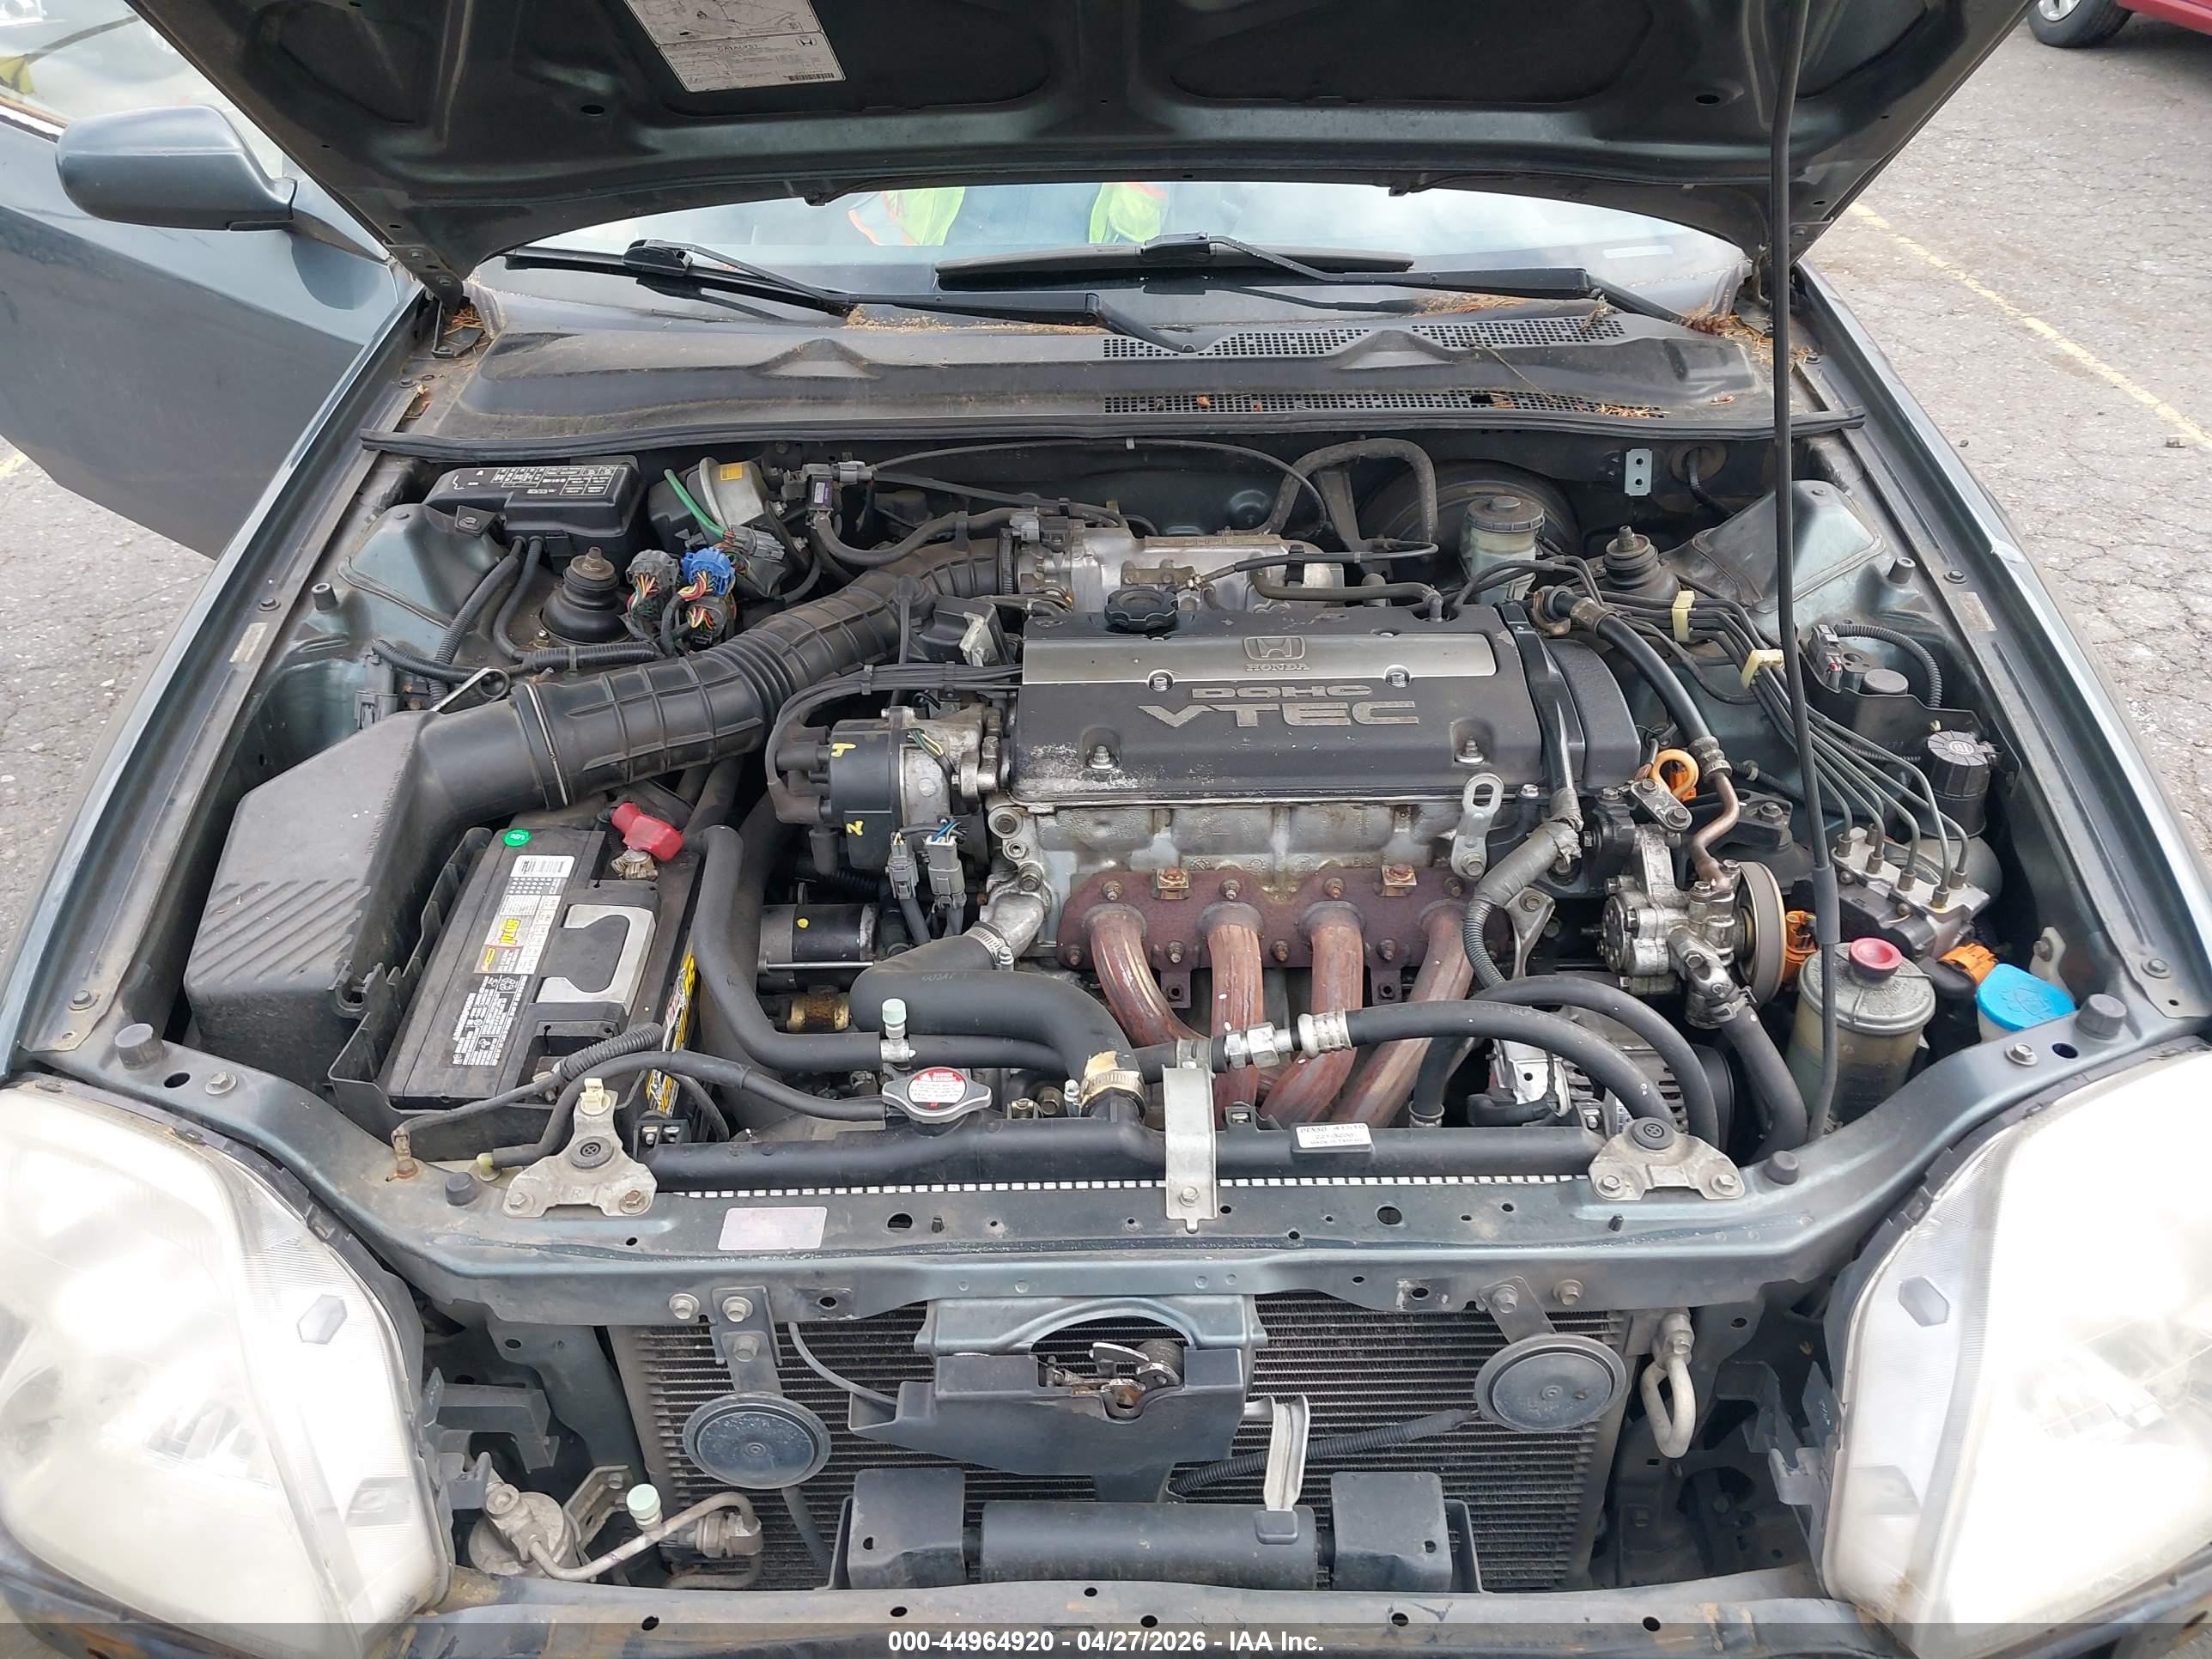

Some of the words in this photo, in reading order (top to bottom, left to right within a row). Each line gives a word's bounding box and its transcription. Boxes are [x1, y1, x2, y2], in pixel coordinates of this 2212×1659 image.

[1245, 663, 1310, 672] HONDA
[1192, 685, 1372, 699] DOHC
[1138, 701, 1419, 727] VTEC
